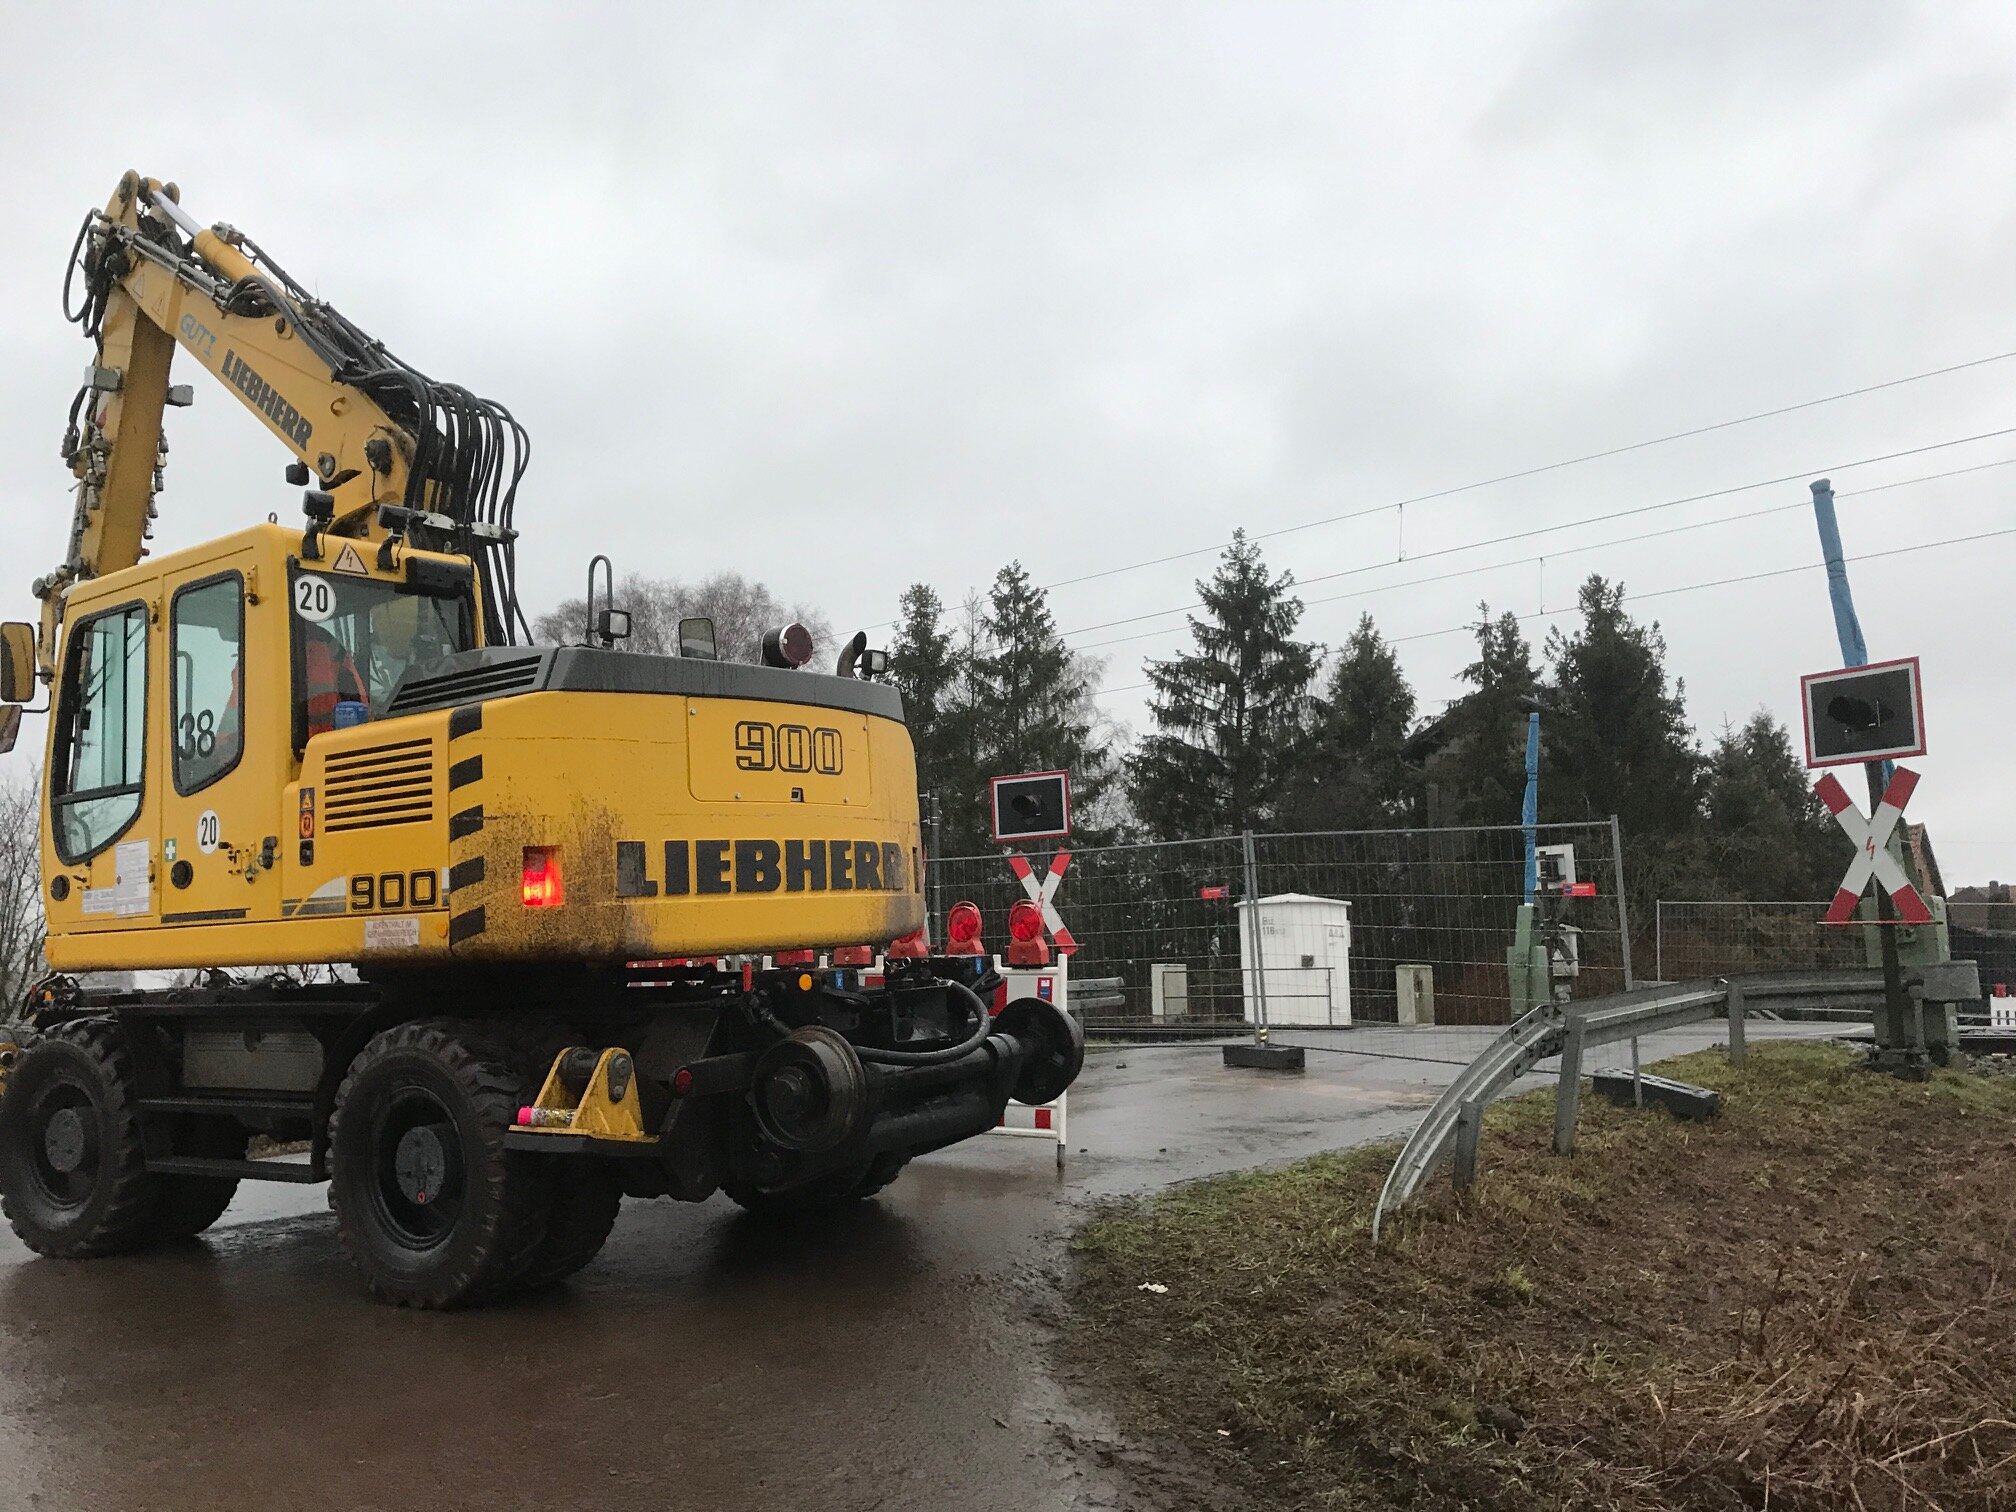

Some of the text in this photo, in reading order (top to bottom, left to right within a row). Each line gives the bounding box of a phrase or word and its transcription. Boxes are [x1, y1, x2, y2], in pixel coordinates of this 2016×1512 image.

[221, 348, 313, 452] LIEBHERR
[299, 581, 329, 613] 20
[178, 709, 216, 761] 38
[734, 720, 843, 776] 900
[200, 815, 217, 846] 20
[350, 868, 438, 912] 900
[616, 839, 903, 898] LIEBHERR
